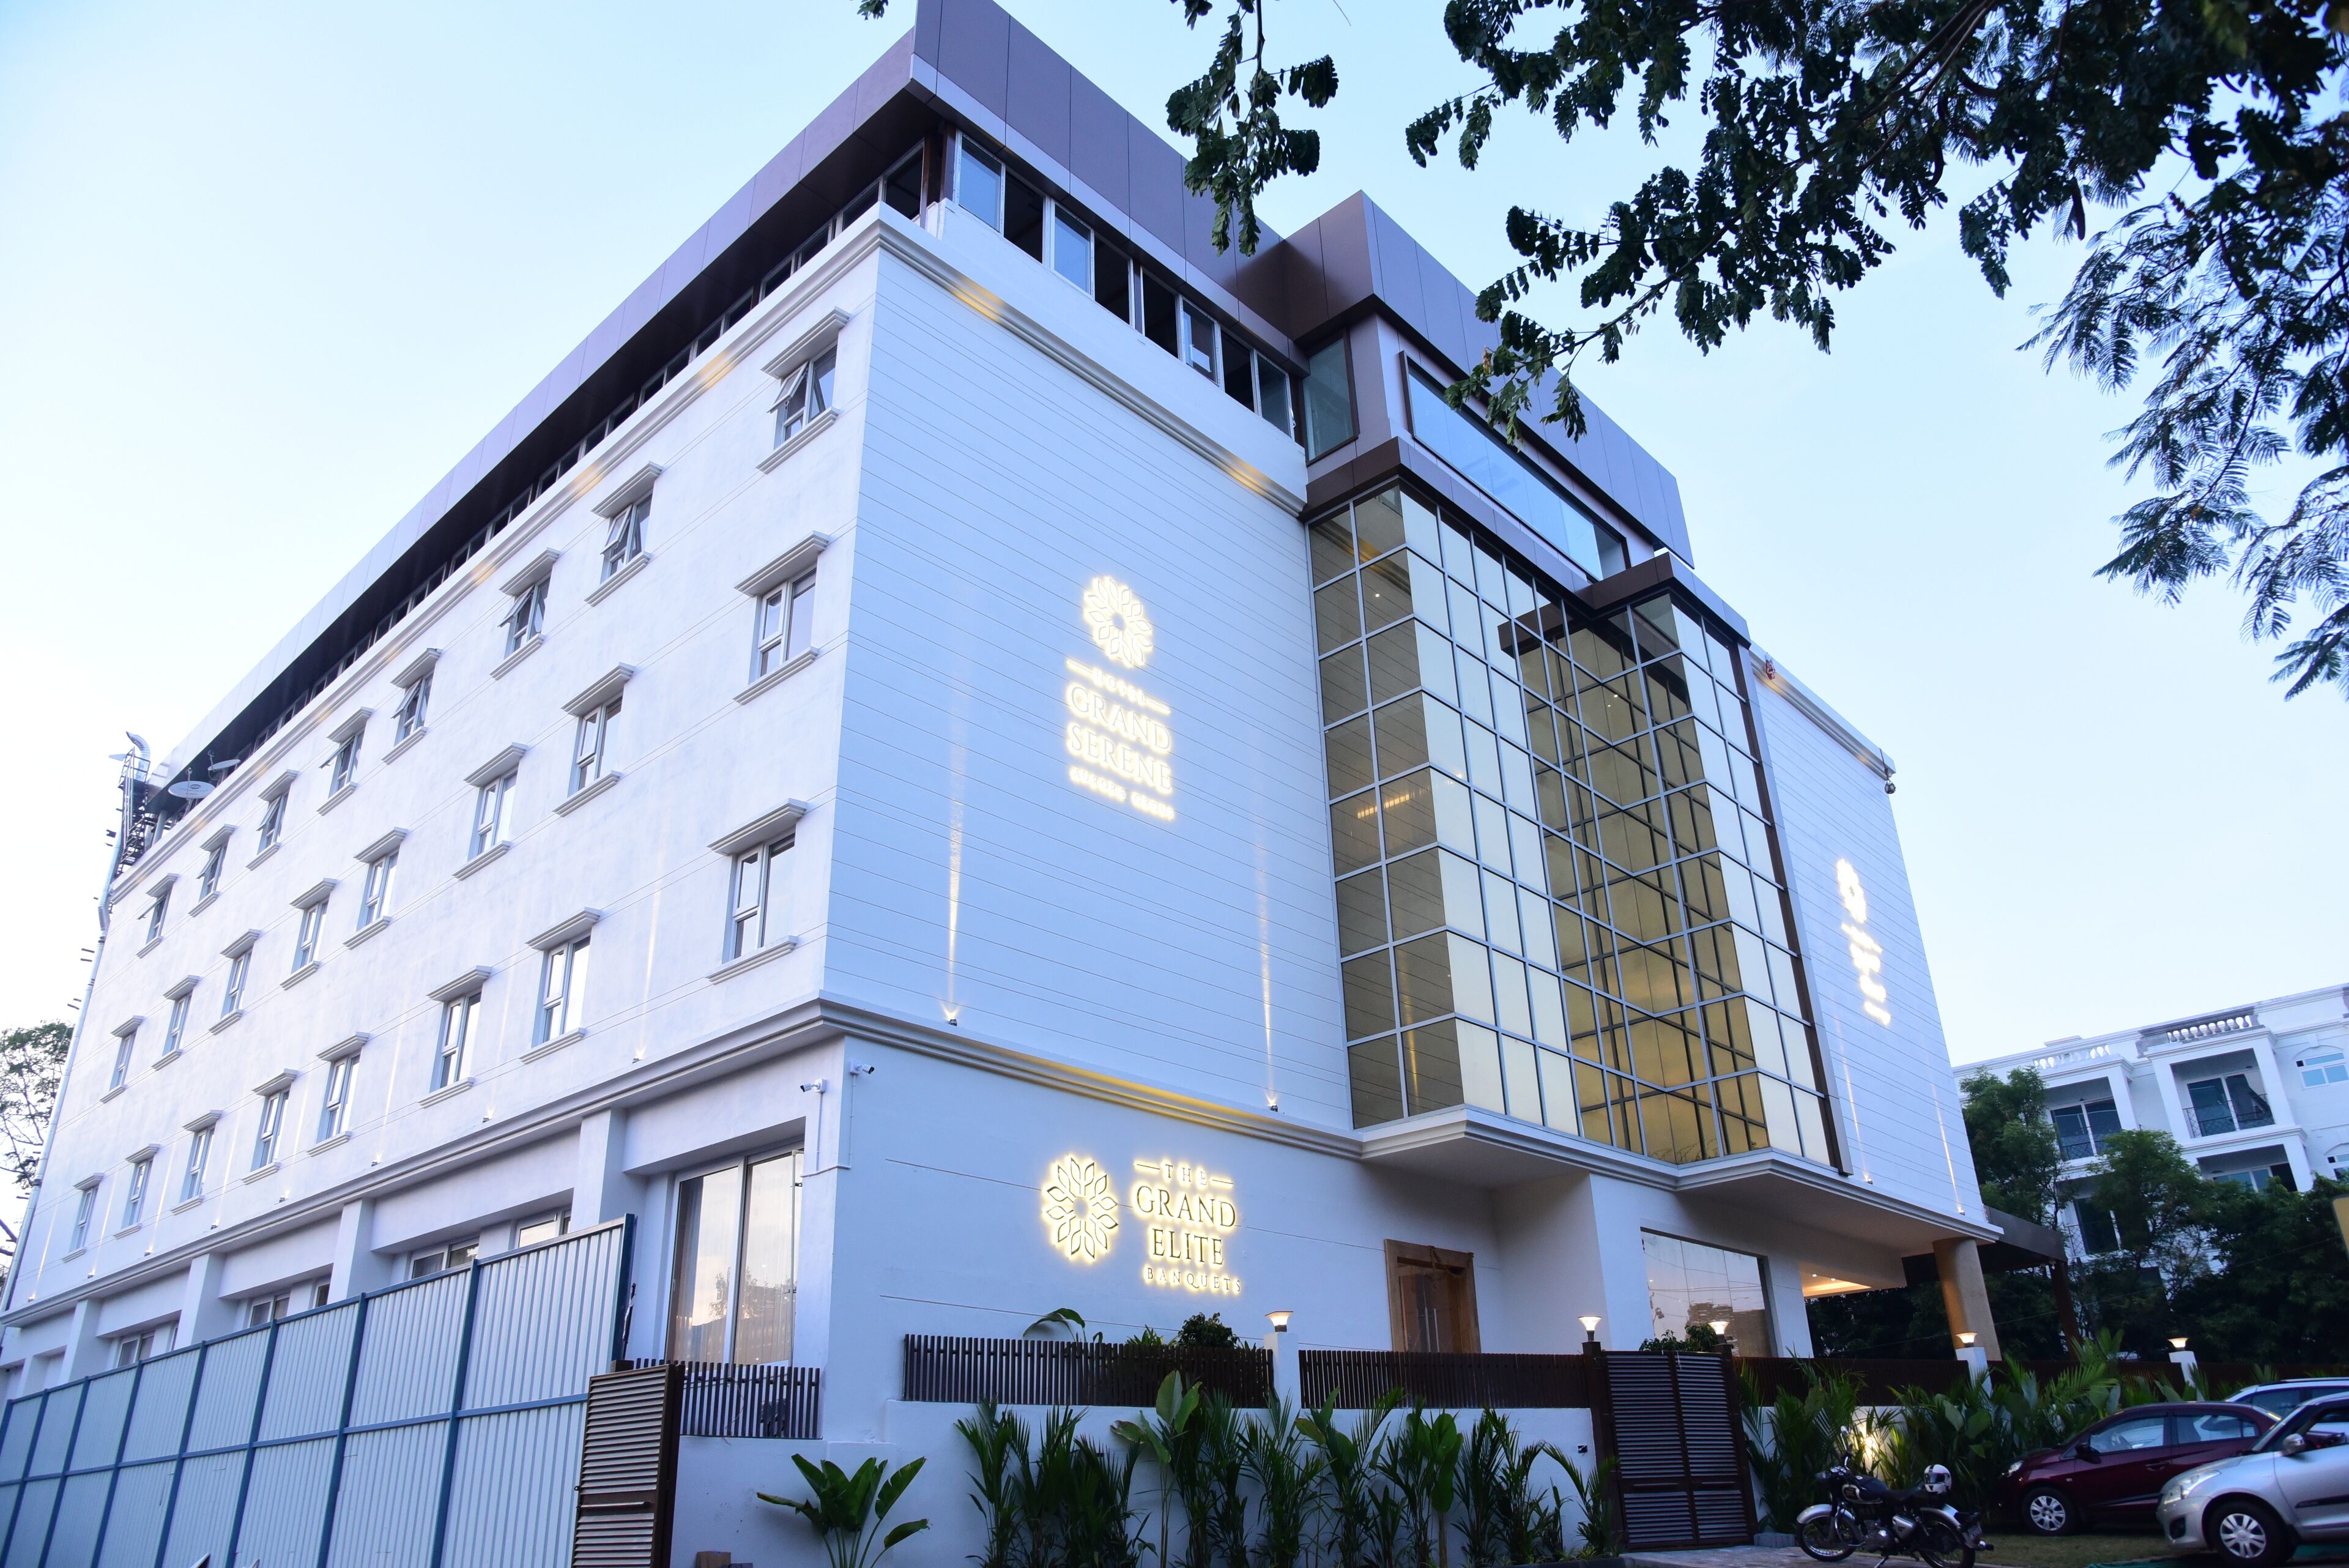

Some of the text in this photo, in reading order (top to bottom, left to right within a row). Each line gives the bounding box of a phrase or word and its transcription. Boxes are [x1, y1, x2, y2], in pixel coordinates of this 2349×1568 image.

[1094, 669, 1147, 704] HOTEL
[1071, 686, 1171, 751] GRAND
[1071, 724, 1172, 790] SERENE
[1073, 768, 1126, 798] AURORA
[1165, 1164, 1207, 1186] THE
[1136, 1185, 1236, 1227] GRAND
[1152, 1228, 1224, 1265] ELITE
[1146, 1267, 1241, 1293] BANQUETS
